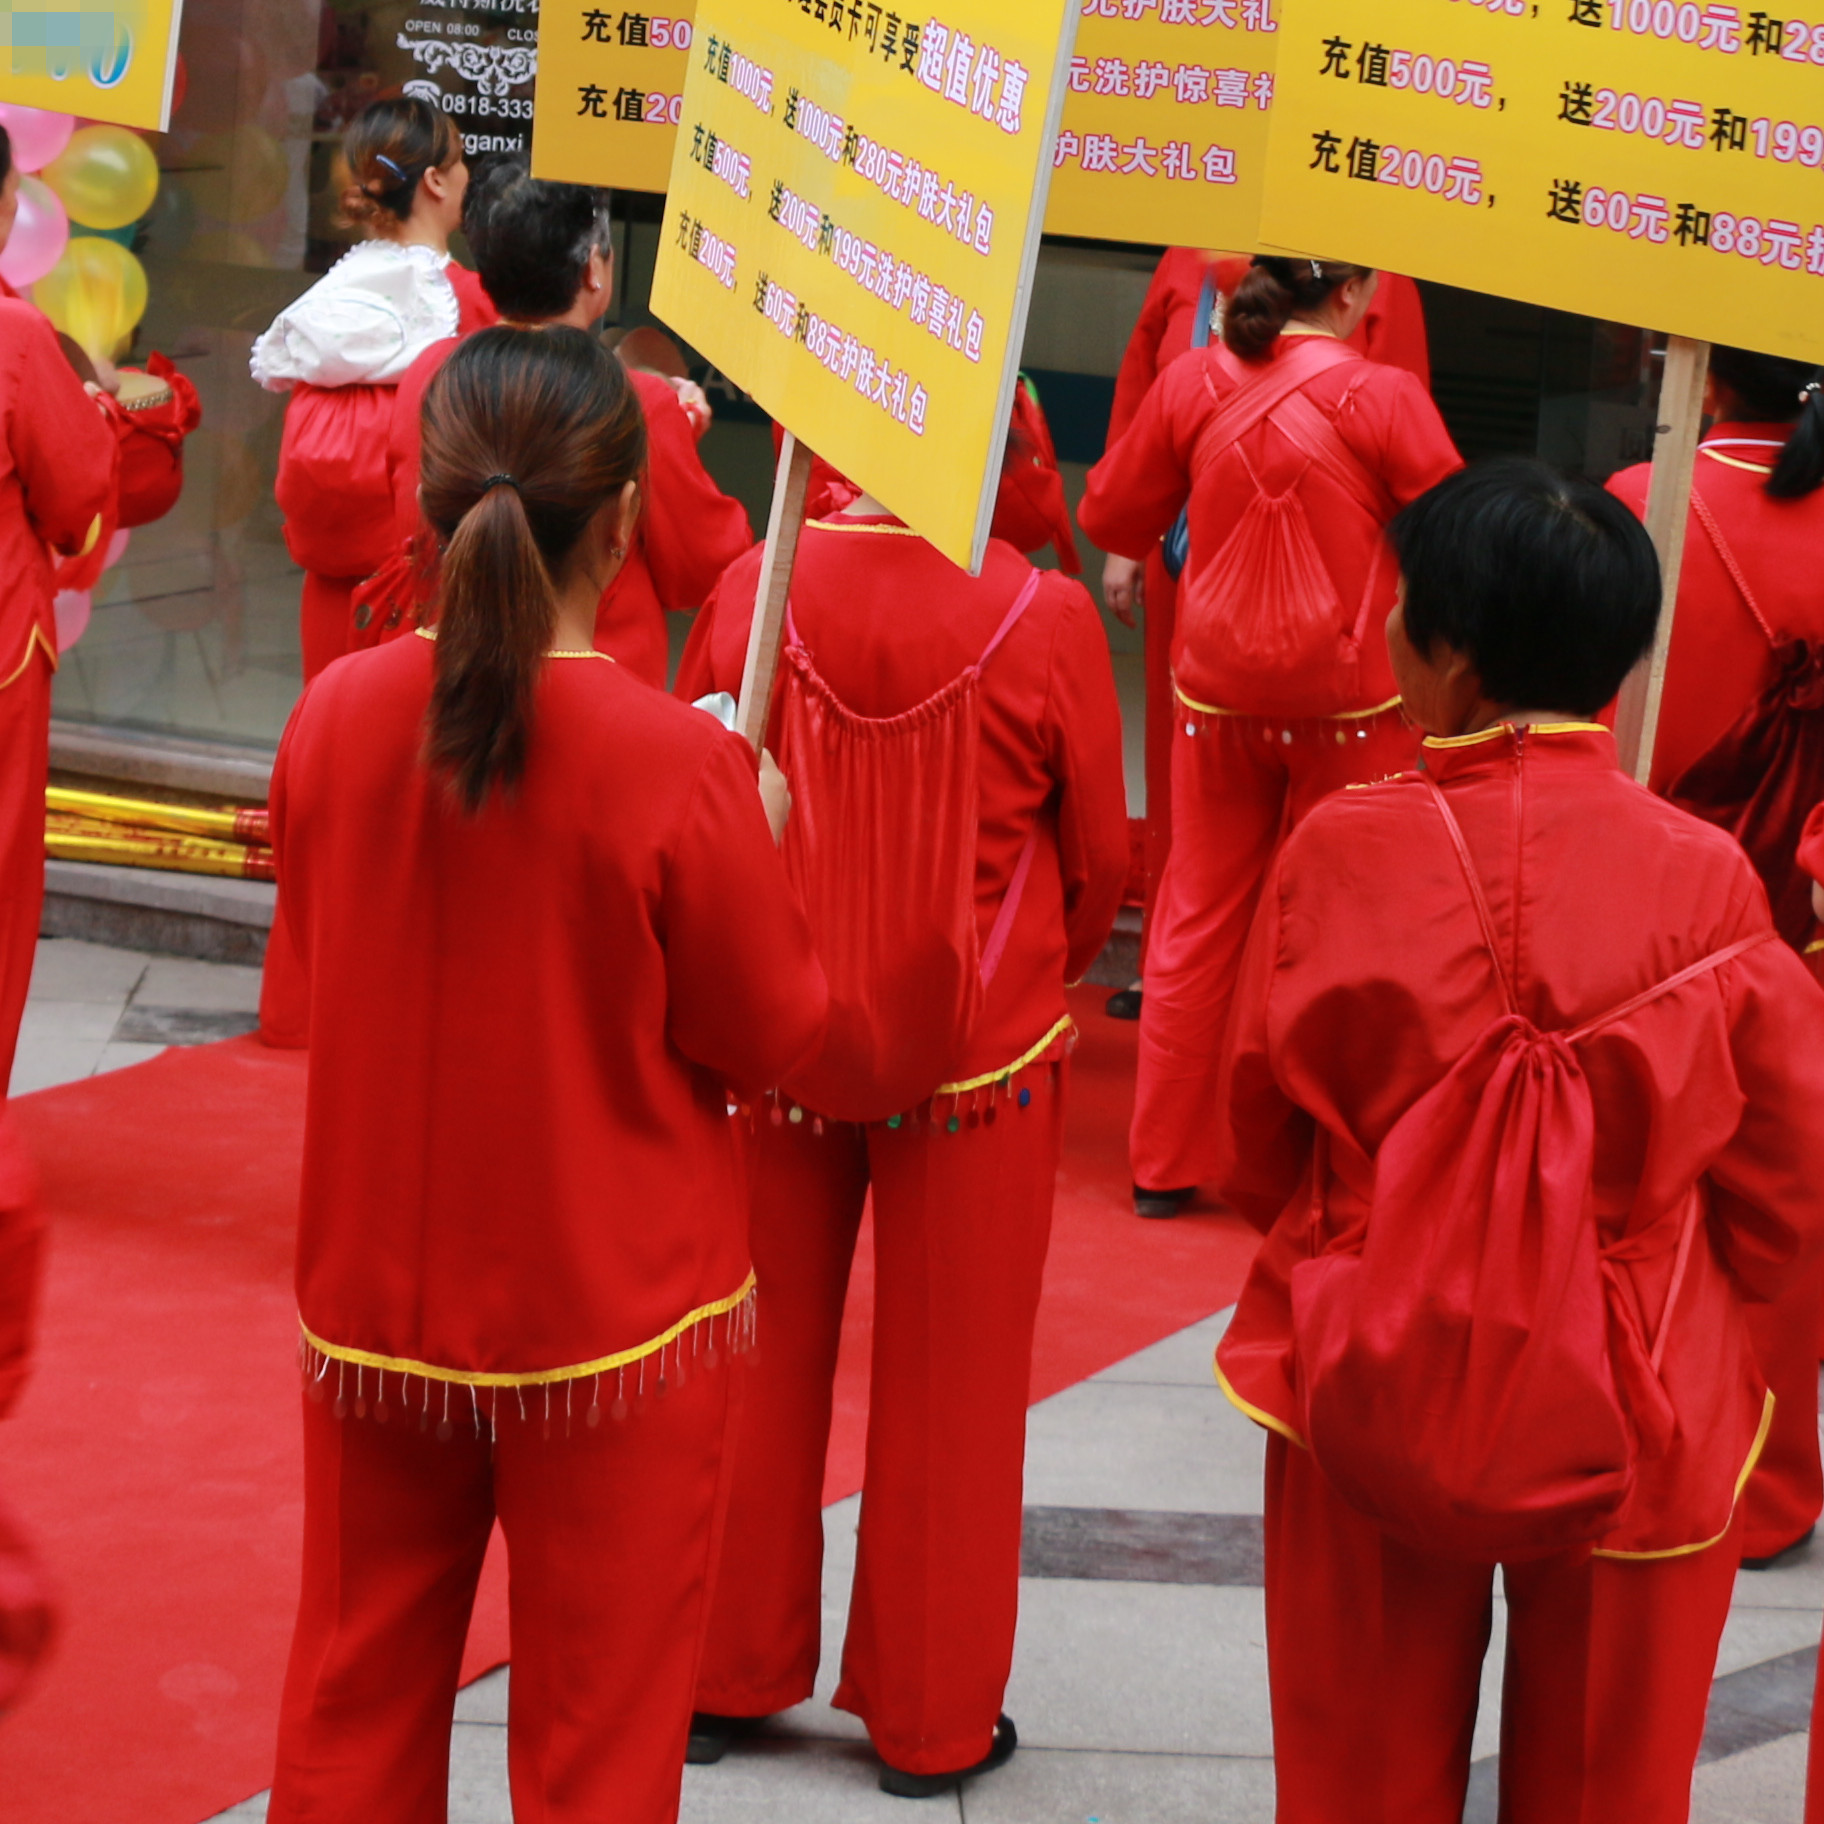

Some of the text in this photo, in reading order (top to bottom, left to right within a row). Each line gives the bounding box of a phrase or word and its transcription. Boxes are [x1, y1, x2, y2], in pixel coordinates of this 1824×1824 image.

[405, 19, 441, 34] OPEN
[446, 21, 480, 37] 08:00
[581, 8, 693, 51] 充值50
[442, 93, 534, 119] 0818-333
